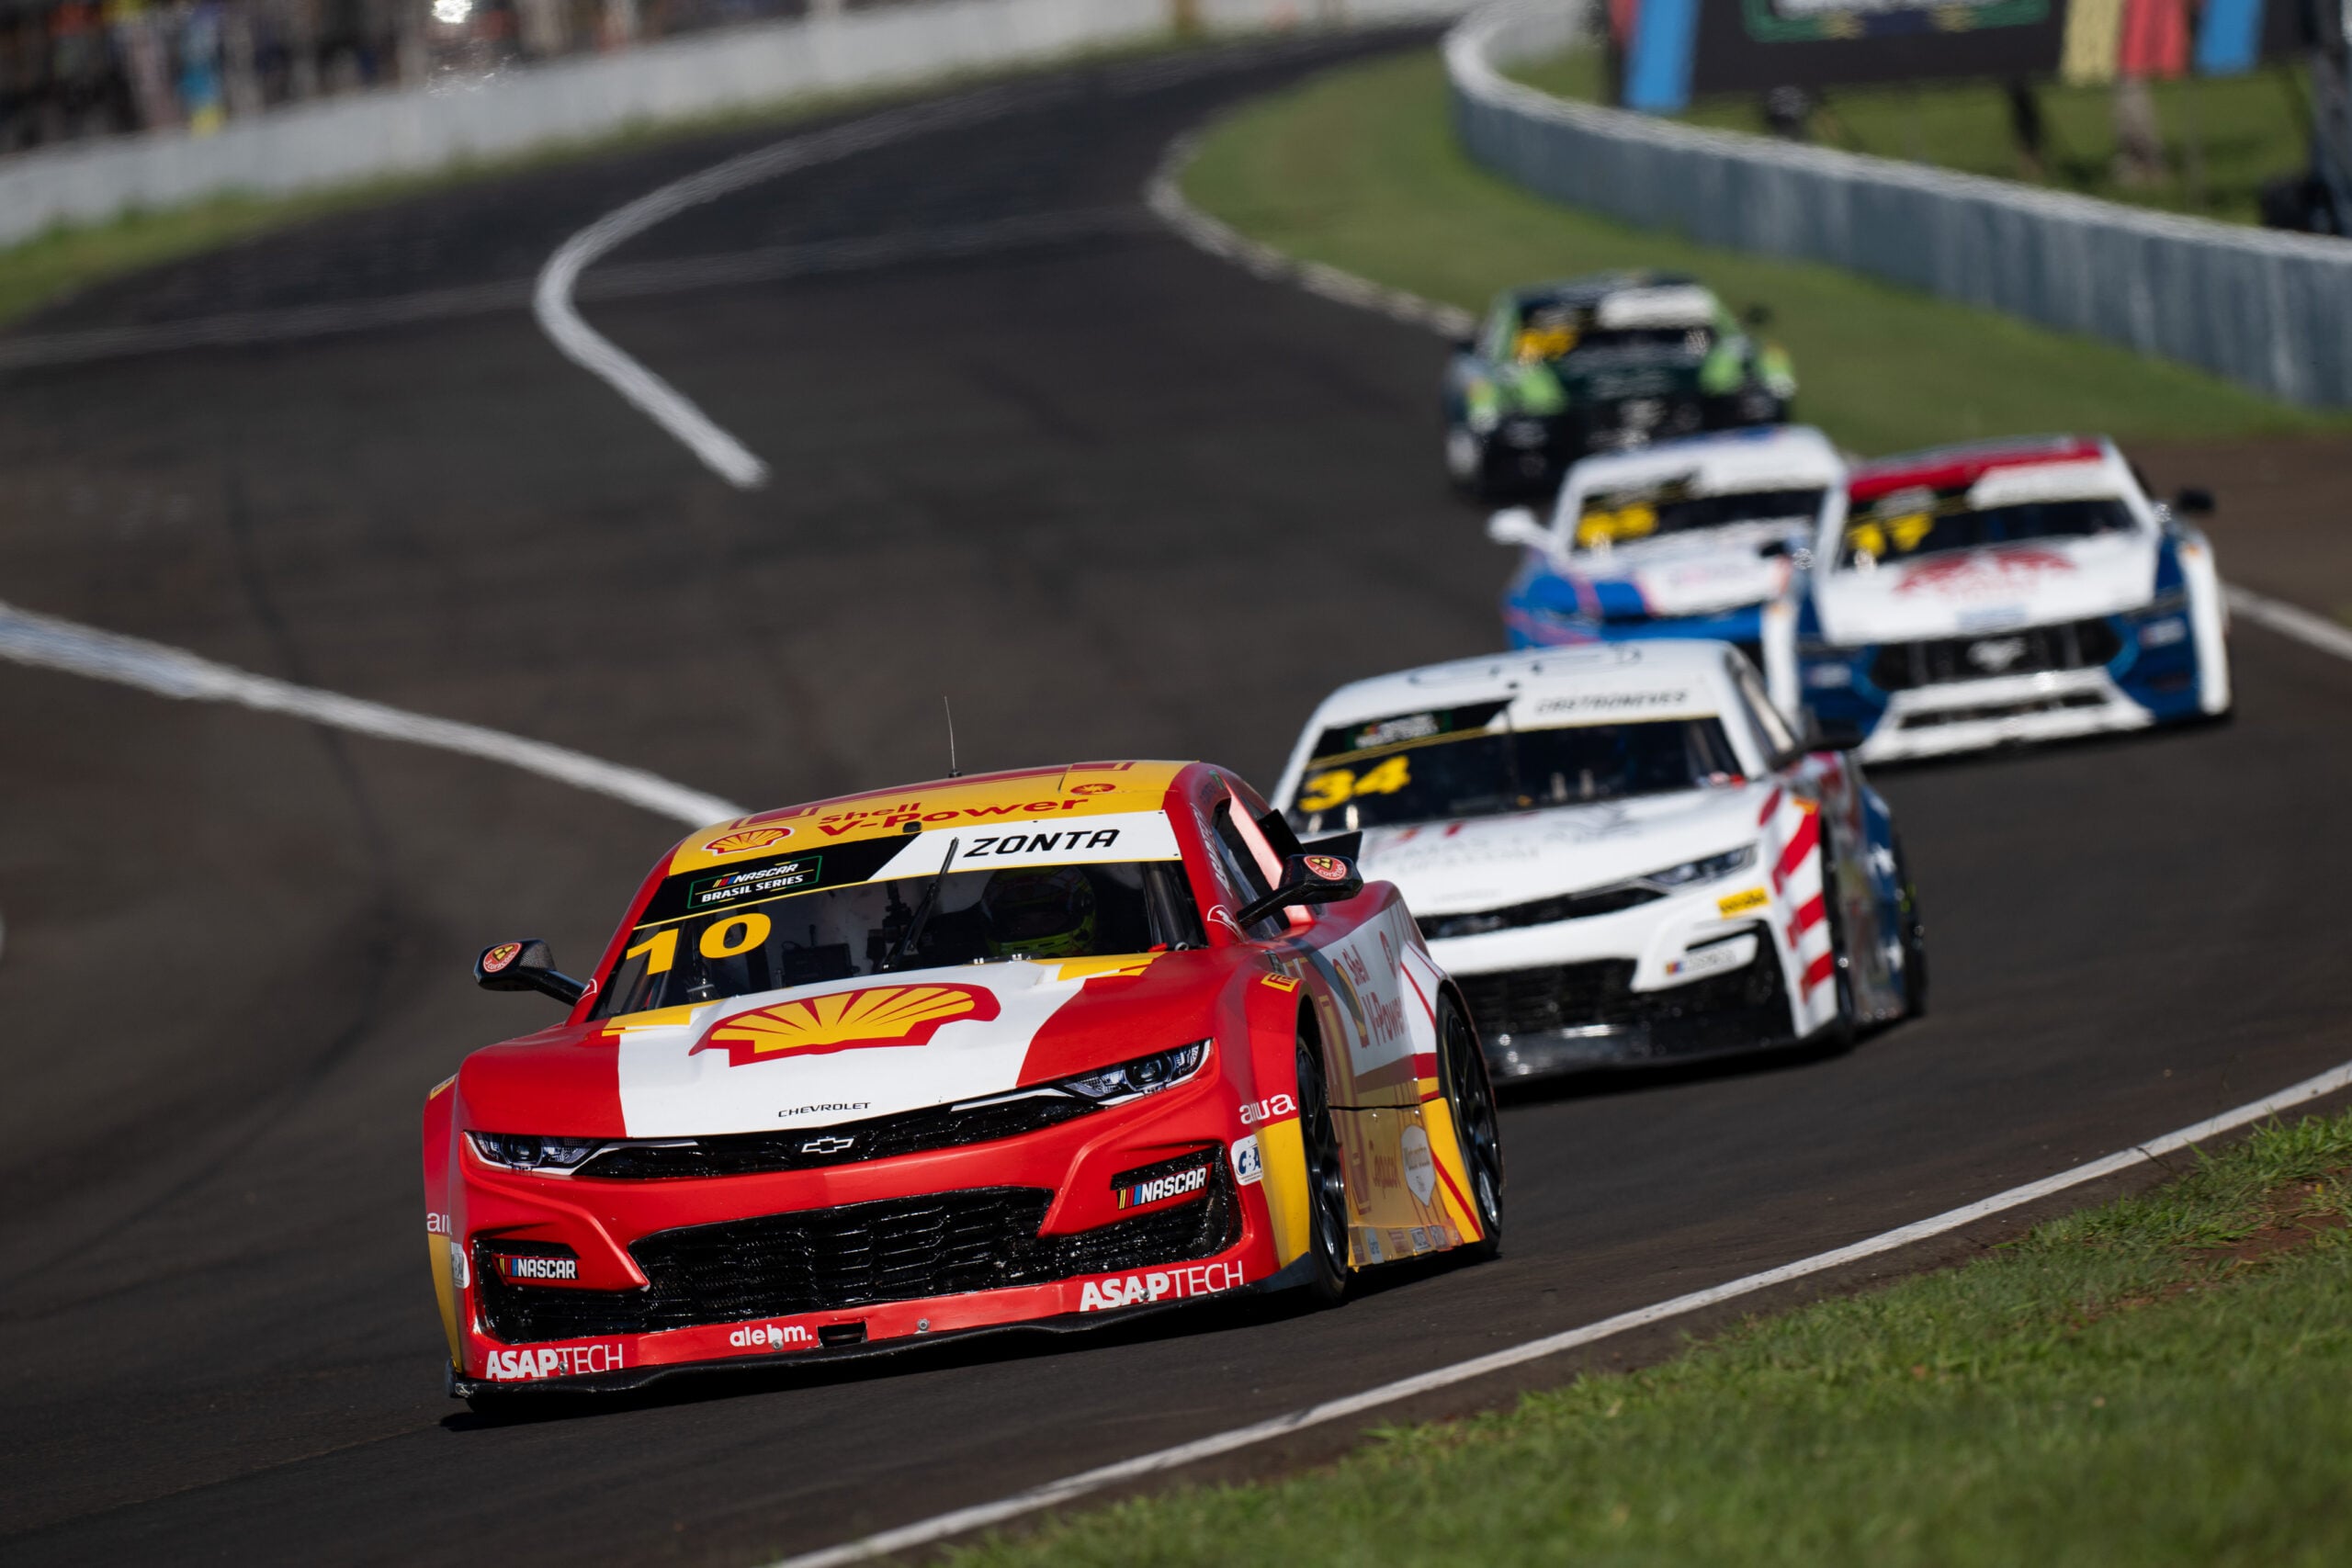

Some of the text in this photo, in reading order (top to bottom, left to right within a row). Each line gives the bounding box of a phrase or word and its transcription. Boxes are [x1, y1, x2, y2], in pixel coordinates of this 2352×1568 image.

[1297, 755, 1411, 813] 34
[817, 799, 1090, 837] V-Power
[963, 829, 1121, 858] ZONTA
[701, 874, 804, 903] BRASIL SERIES
[733, 863, 799, 884] NASCAR
[626, 912, 772, 976] 10
[778, 1101, 872, 1118] CHEVROLET
[1140, 1167, 1207, 1205] NASCAR
[517, 1258, 577, 1280] NASCAR
[1080, 1260, 1244, 1313] ASAPTECH
[485, 1343, 624, 1381] ASAPTECH
